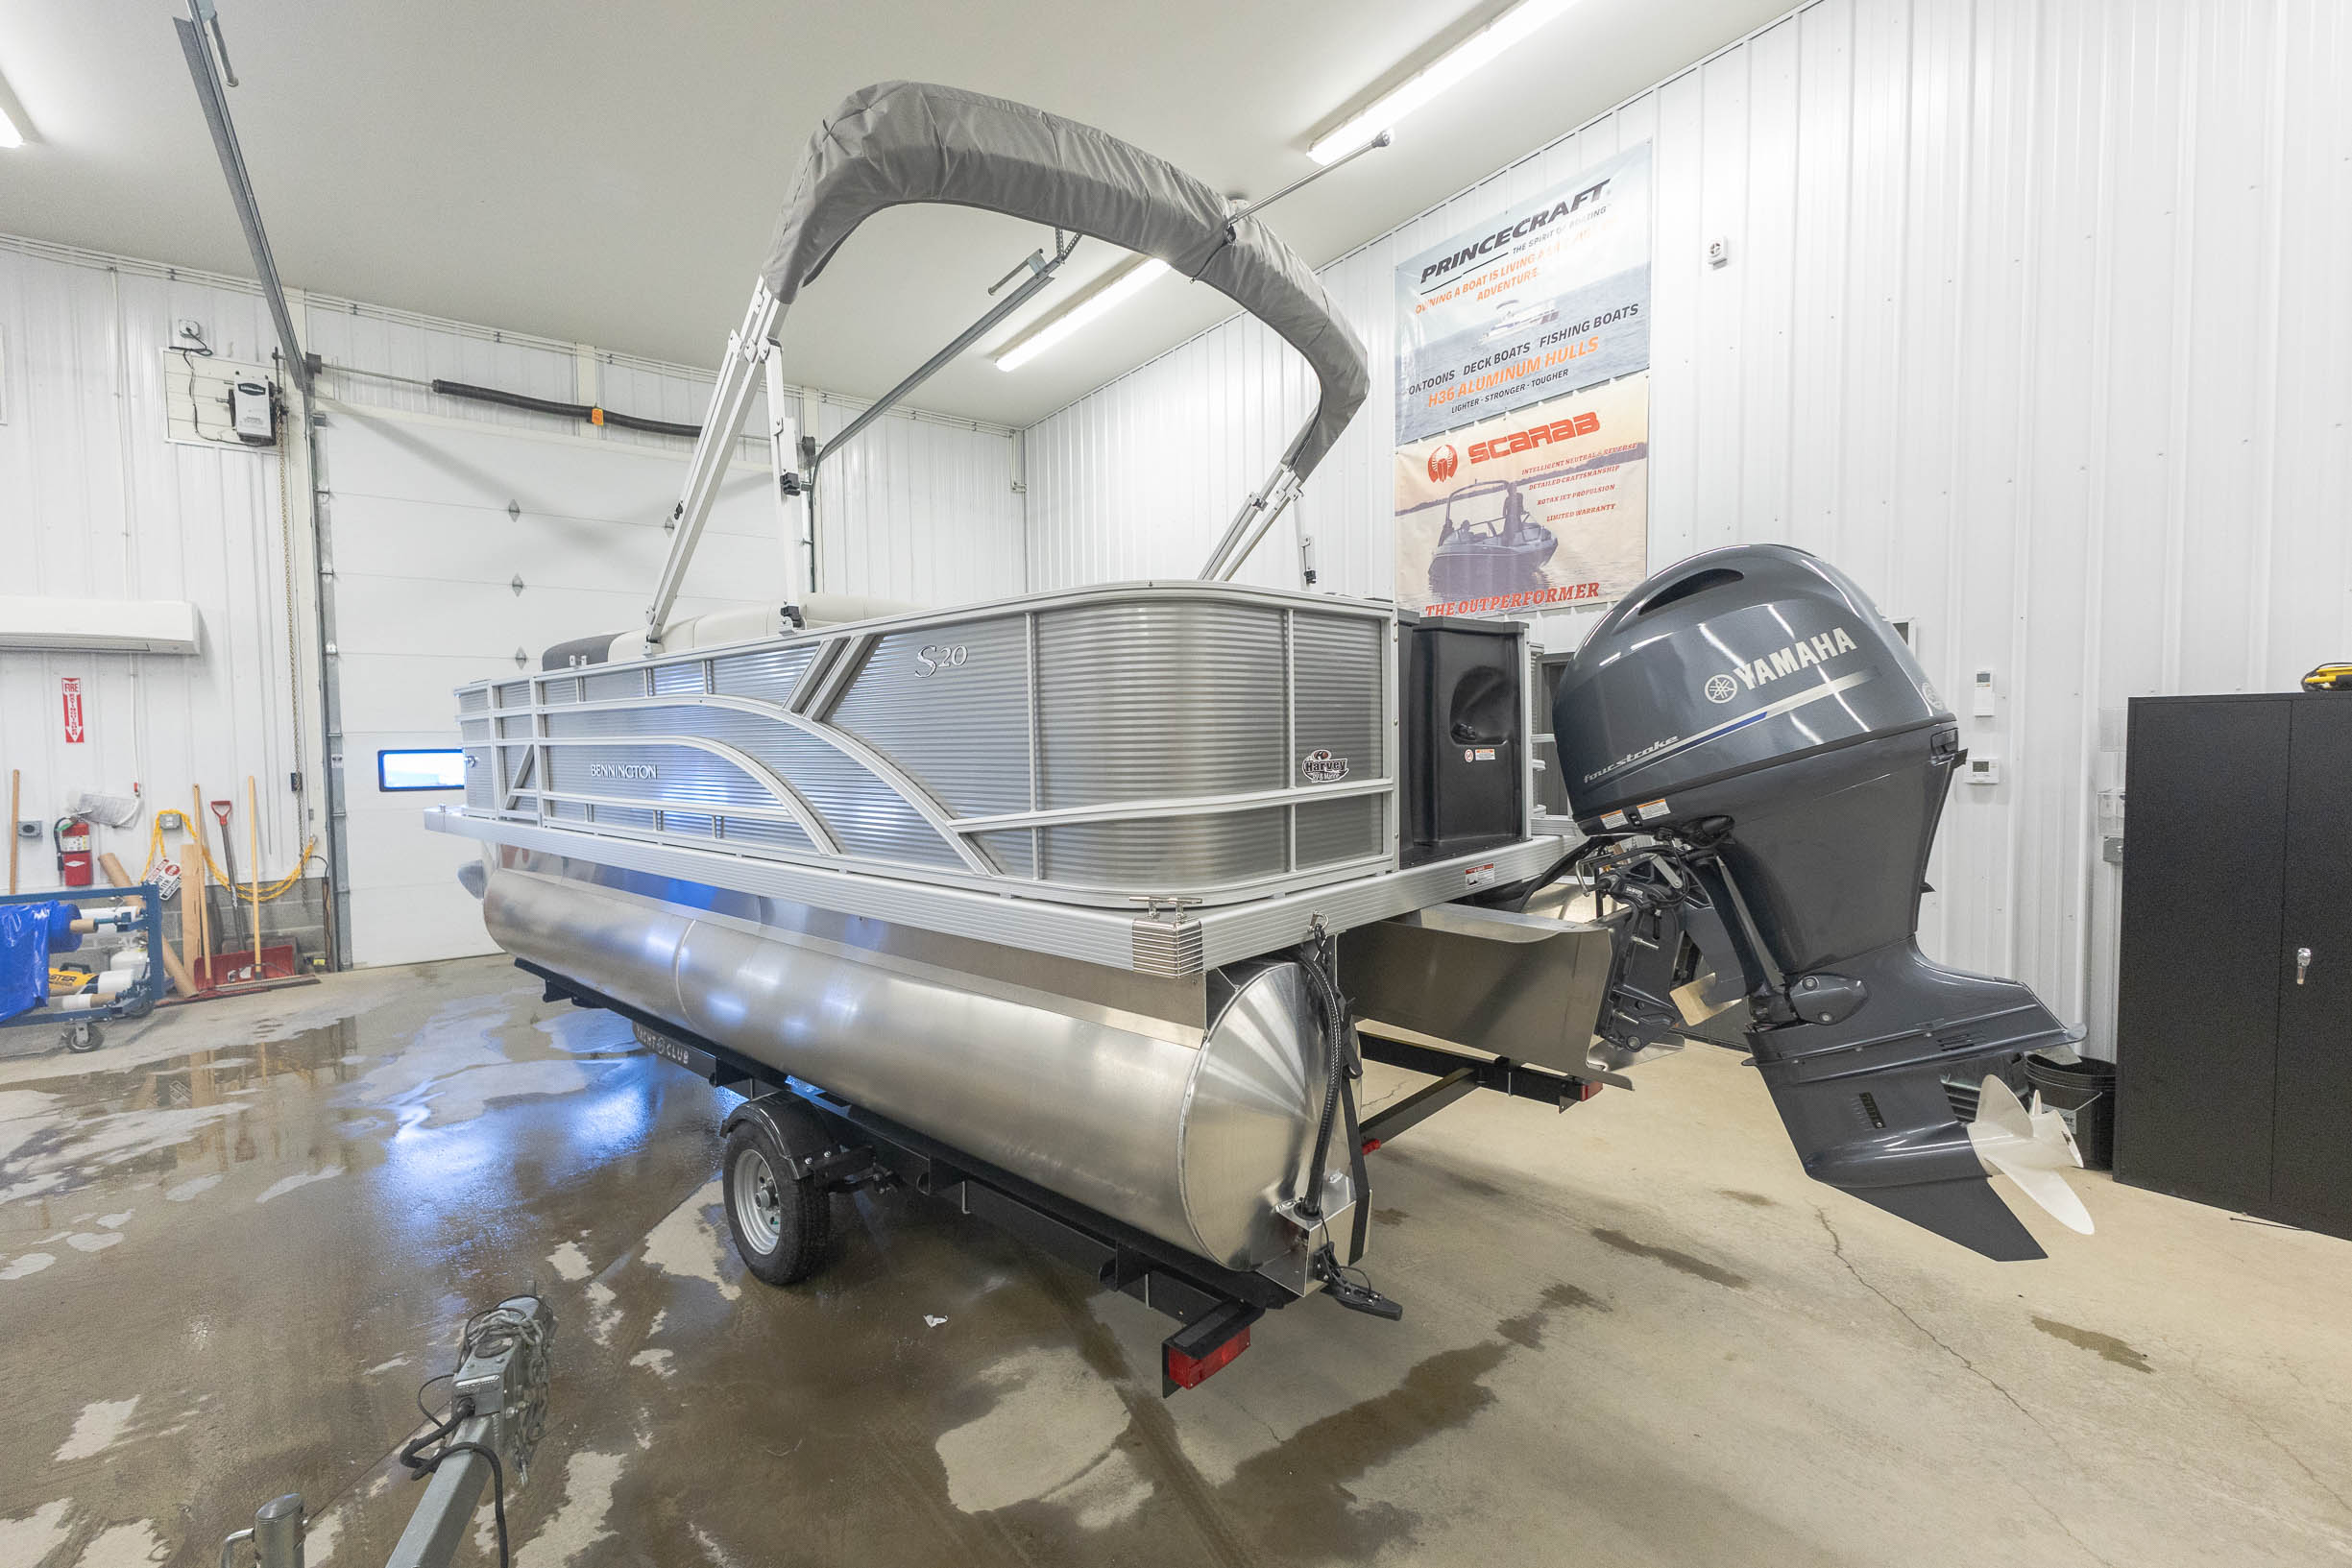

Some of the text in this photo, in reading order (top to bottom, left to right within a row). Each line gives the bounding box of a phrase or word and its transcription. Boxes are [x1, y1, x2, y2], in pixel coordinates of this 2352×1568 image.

[1420, 179, 1611, 284] PRINCECRAFT
[1514, 242, 1526, 253] THE
[1529, 229, 1554, 248] SPIRIT
[1454, 289, 1461, 298] A
[1462, 275, 1488, 293] BOAT
[1489, 269, 1498, 281] IS
[1500, 253, 1537, 277] LIVING
[1476, 266, 1539, 302] ADVENTURE
[1408, 303, 1638, 396] ONTOONS DECK BOATS FISHING BOATS
[1428, 336, 1599, 408] H36 ALUMINUM HULLS
[1451, 368, 1568, 414] LIGHTER STRONGER TOUGHER
[1521, 460, 1564, 475] INTELLIGENT
[1565, 452, 1595, 465] NEUTRAL
[1603, 443, 1637, 455] REVERSE
[1529, 465, 1620, 491] DETAILED CRAFTSMANSHIP
[1560, 492, 1571, 501] JET
[1572, 484, 1615, 498] PROPULSION
[1546, 503, 1616, 522] LIMITED WARRANTY
[1425, 582, 1600, 617] THE OUTPERFORMER
[1733, 627, 1857, 690] YAMAHA
[591, 763, 658, 779] BENNINGTON
[1305, 760, 1346, 773] Harvey
[667, 1043, 689, 1064] CLUB
